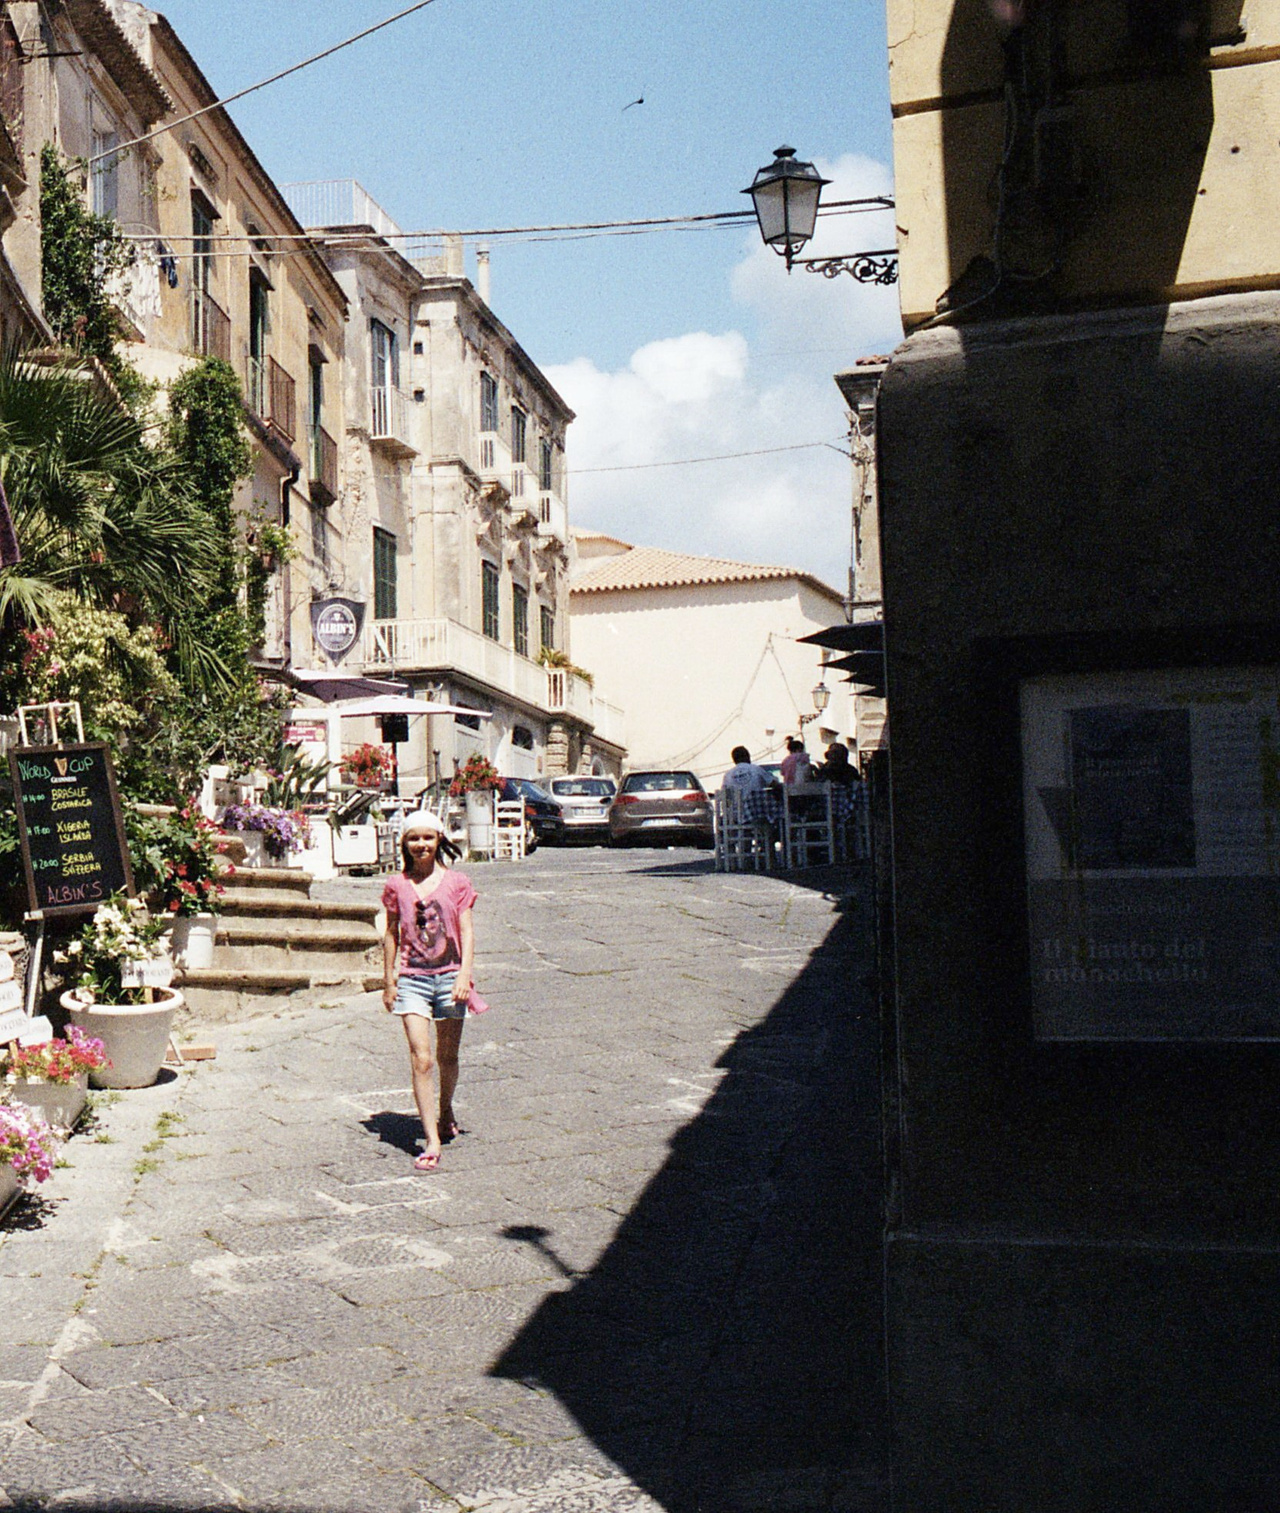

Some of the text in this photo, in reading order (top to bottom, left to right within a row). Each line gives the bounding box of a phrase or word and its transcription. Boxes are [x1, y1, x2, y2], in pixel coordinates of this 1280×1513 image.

[319, 622, 354, 634] ALBIN'S
[18, 756, 94, 781] WORLD CUP
[51, 786, 88, 801] BRASILE
[62, 851, 95, 866] SERBIA
[62, 862, 102, 877] SVIZZERA
[47, 881, 103, 904] ALBIN'S
